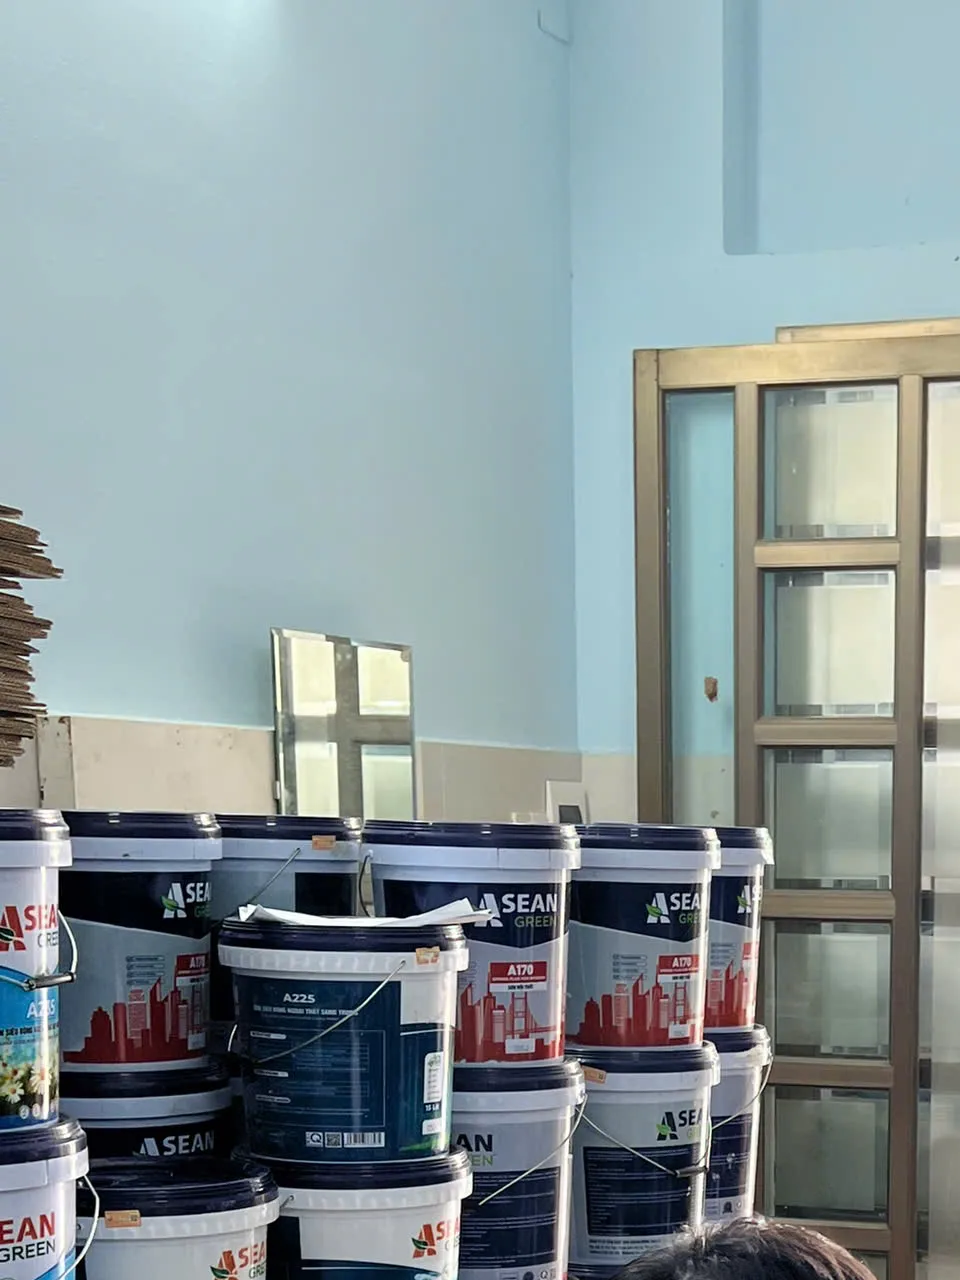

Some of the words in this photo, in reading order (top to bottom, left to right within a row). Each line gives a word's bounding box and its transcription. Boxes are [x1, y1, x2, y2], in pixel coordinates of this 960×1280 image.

[161, 882, 212, 919] ASEA
[474, 893, 558, 927] ASEAN
[646, 892, 701, 924] ASEA
[0, 903, 58, 951] ASEA
[679, 913, 701, 924] GRE
[507, 964, 534, 976] A170
[283, 993, 316, 1004] A225
[656, 1109, 702, 1141] ASEA
[139, 1130, 215, 1157] ASEAN
[0, 1211, 56, 1246] EAN
